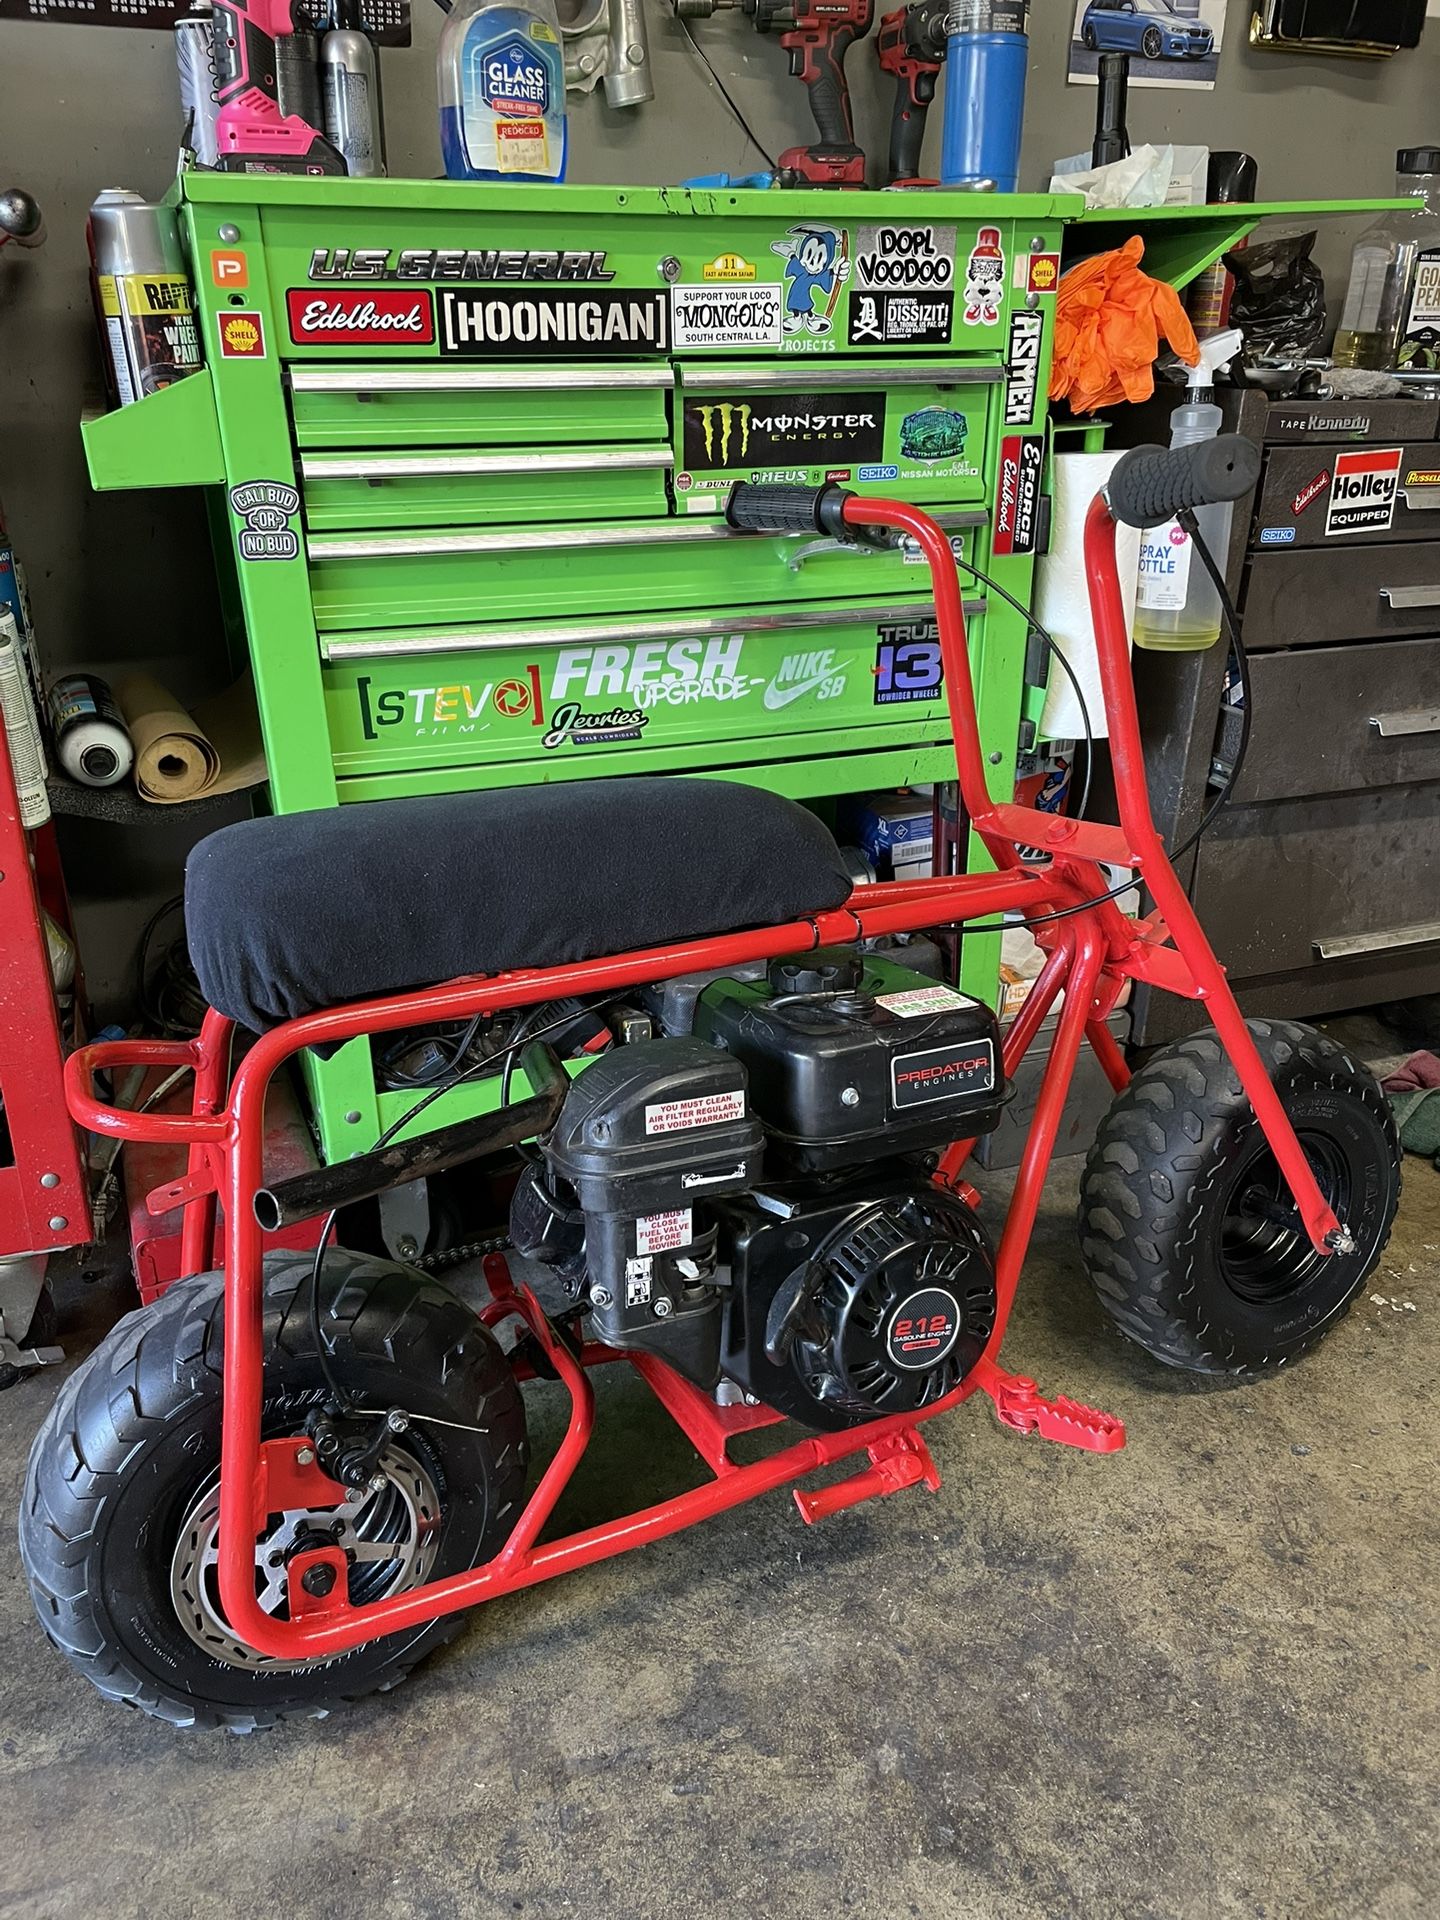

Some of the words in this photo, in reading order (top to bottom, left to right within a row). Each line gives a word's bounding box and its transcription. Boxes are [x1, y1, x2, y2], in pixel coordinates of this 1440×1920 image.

[488, 62, 544, 87] GLASS
[489, 82, 544, 101] CLEANER
[502, 126, 539, 136] REDUCED
[879, 228, 936, 258] DOPL
[217, 260, 241, 279] P
[309, 248, 388, 280] U.S.
[397, 250, 616, 280] GENERAL
[724, 258, 736, 269] 11
[859, 253, 951, 286] VOODOO
[1035, 270, 1053, 278] SHELL
[1420, 267, 1440, 286] GO
[684, 292, 724, 301] SUPPORT
[725, 291, 747, 300] YOUR
[750, 291, 771, 300] LOCO
[888, 298, 917, 306] AUTHENTIC
[301, 300, 423, 332] Edelbrock
[443, 292, 666, 350] [HOONIGAN]
[676, 301, 780, 328] MONGOLS
[229, 330, 255, 340] SHELL
[686, 333, 713, 342] SOUTH
[716, 332, 754, 342] CENTRAL
[756, 332, 770, 340] L.A.
[778, 340, 836, 352] PROJECTS
[751, 414, 876, 432] MONSTER
[1280, 420, 1306, 430] TAPE
[1308, 416, 1370, 434] Kennedy
[771, 431, 857, 442] ENERGY
[860, 467, 896, 479] SEIKO
[901, 470, 933, 478] NISSAN
[936, 468, 970, 477] MOTORS
[236, 488, 265, 507] CALI
[268, 488, 294, 507] BUD
[998, 458, 1017, 533] Edelbrock
[1294, 475, 1328, 510] Edelbrock
[1332, 475, 1396, 502] Holley
[1014, 468, 1025, 542] SUPERCHARGED
[1331, 510, 1389, 524] EQUIPPED
[247, 537, 264, 552] NO
[268, 536, 291, 551] BUD
[1263, 530, 1294, 540] SEIKO
[1140, 560, 1175, 574] OTTLE
[881, 624, 940, 641] TRUE
[550, 634, 745, 699] FRESH
[777, 649, 836, 682] NIKE
[878, 643, 942, 690] 13
[817, 676, 846, 700] SB
[877, 692, 911, 702] LOWRIDER
[913, 689, 939, 698] WHEELS
[545, 704, 646, 746] Jevries
[897, 1058, 988, 1085] PREDATOR
[914, 1070, 974, 1089] ENGINES
[649, 1116, 663, 1124] AIR
[666, 1110, 694, 1121] FILTER
[696, 1102, 742, 1115] REGULARLY
[661, 1105, 678, 1113] YOU
[680, 1100, 703, 1109] MUST
[706, 1095, 732, 1105] CLEAN
[653, 1124, 665, 1132] OR
[667, 1119, 692, 1129] VOIDS
[694, 1110, 739, 1124] WARRANTY
[643, 1214, 660, 1223] YOU
[662, 1210, 685, 1219] MUST
[651, 1218, 678, 1228] CLOSE
[640, 1228, 661, 1239] FUEL
[664, 1222, 689, 1233] VALVE
[648, 1232, 681, 1244] BEFORE
[648, 1239, 681, 1251] MOVING
[896, 1314, 946, 1336] 212
[893, 1333, 926, 1342] GASOLINE
[927, 1330, 952, 1338] ENGINE
